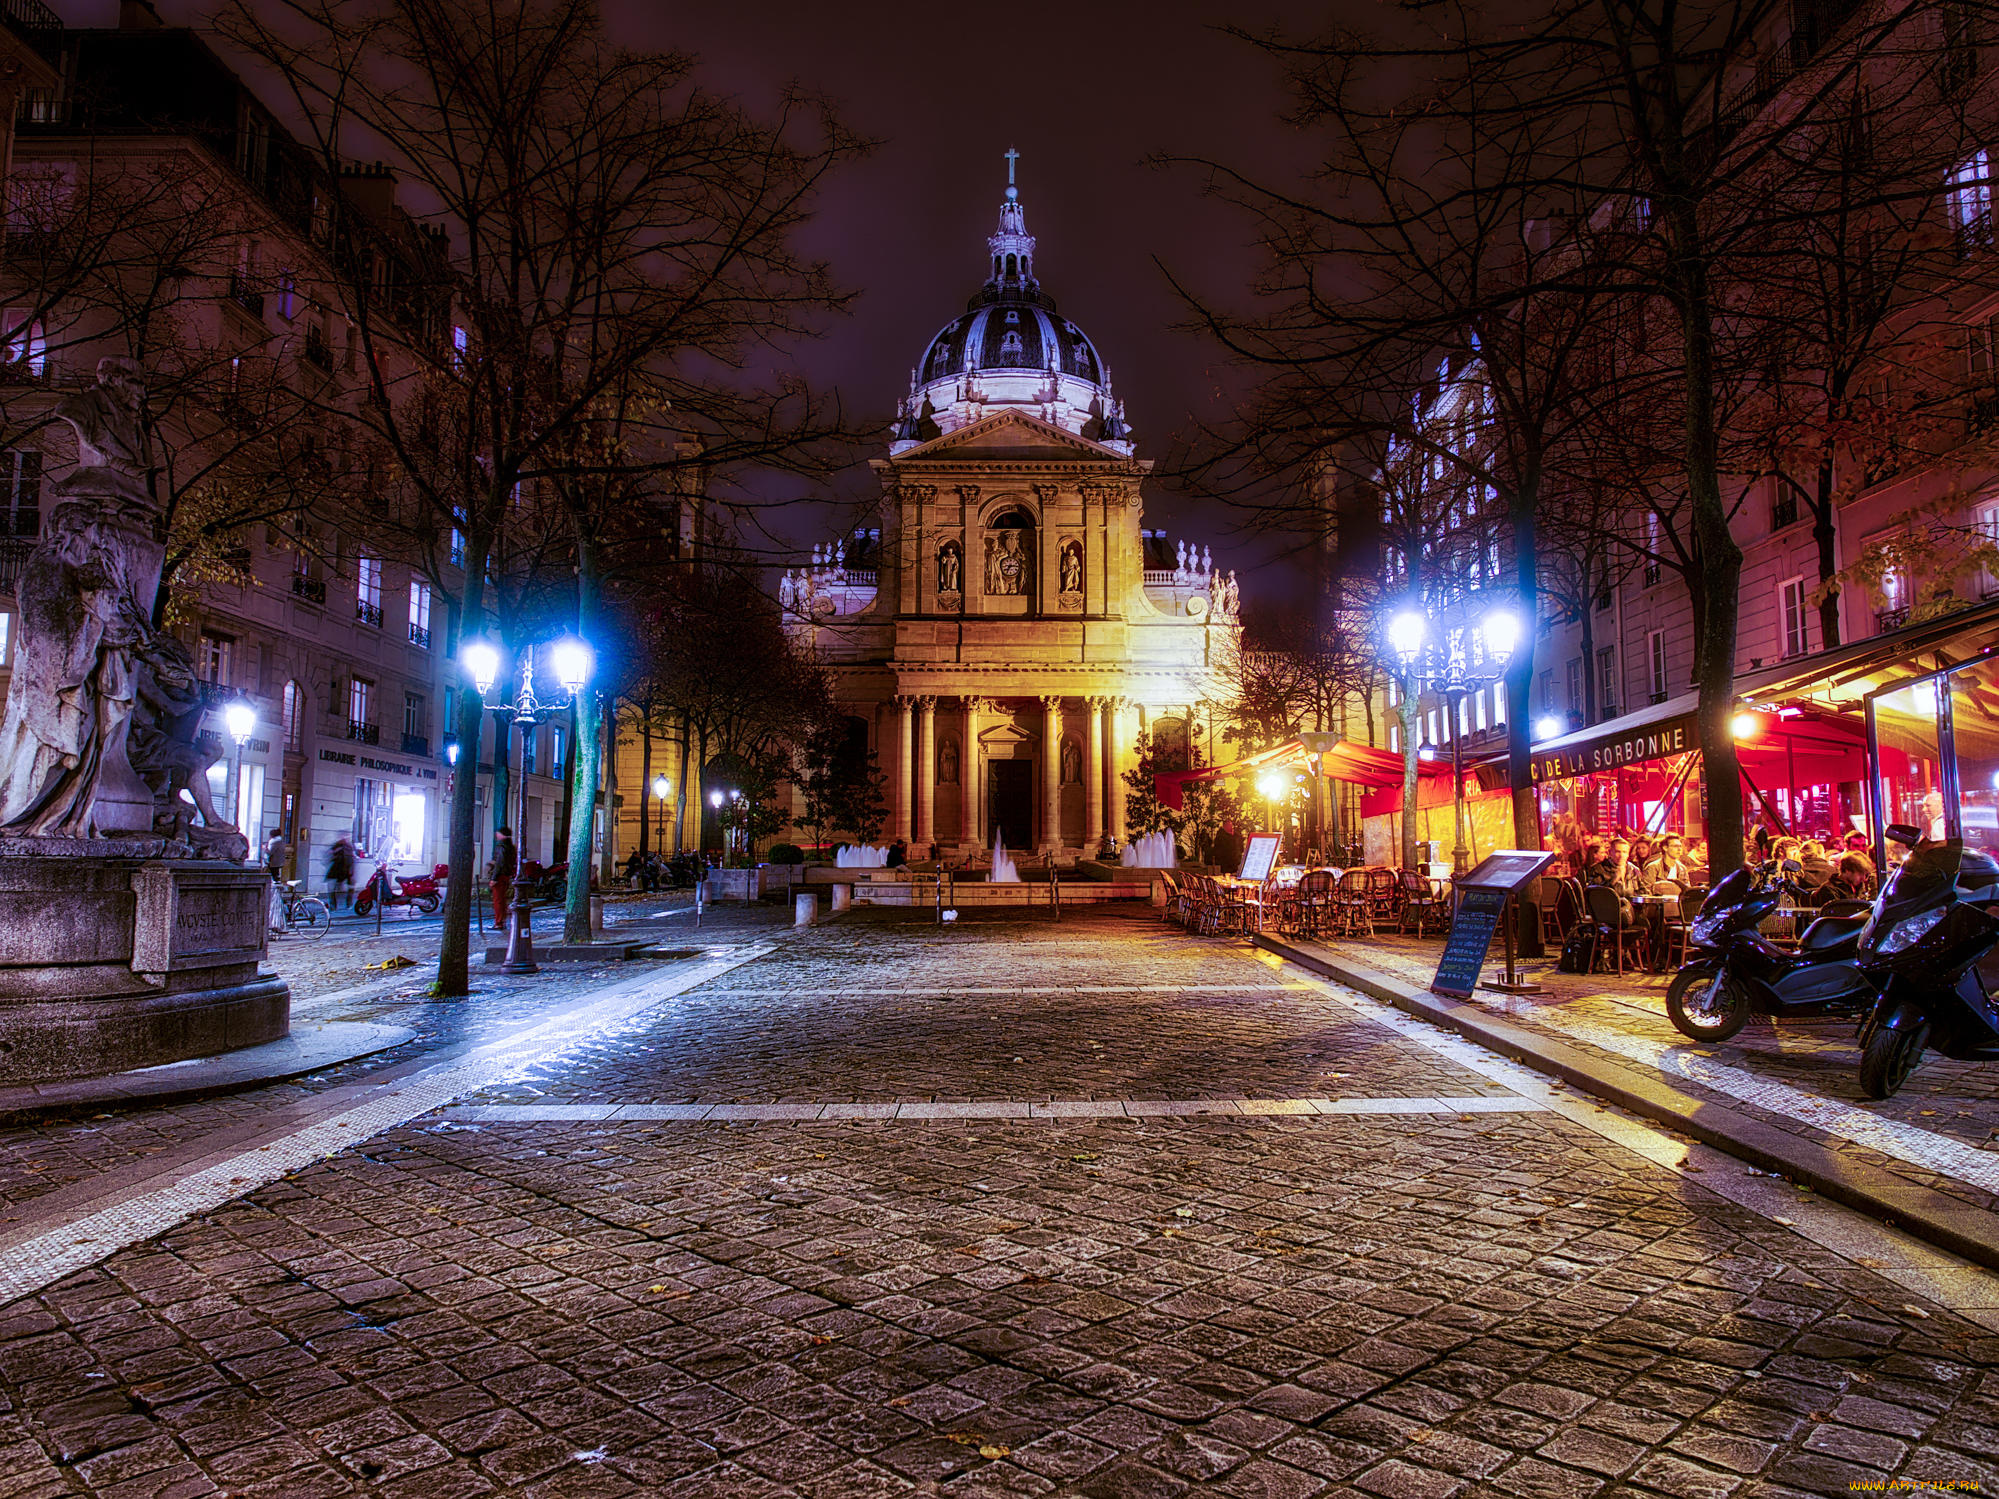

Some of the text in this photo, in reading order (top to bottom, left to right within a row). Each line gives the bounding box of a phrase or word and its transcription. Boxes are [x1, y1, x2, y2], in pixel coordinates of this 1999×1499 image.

[319, 749, 356, 766] LIBRAIRIE
[360, 756, 413, 775] PHILOSOPHIQUE
[1546, 758, 1562, 777] DE
[1570, 754, 1585, 774] LA
[1594, 727, 1684, 768] SORBONNE
